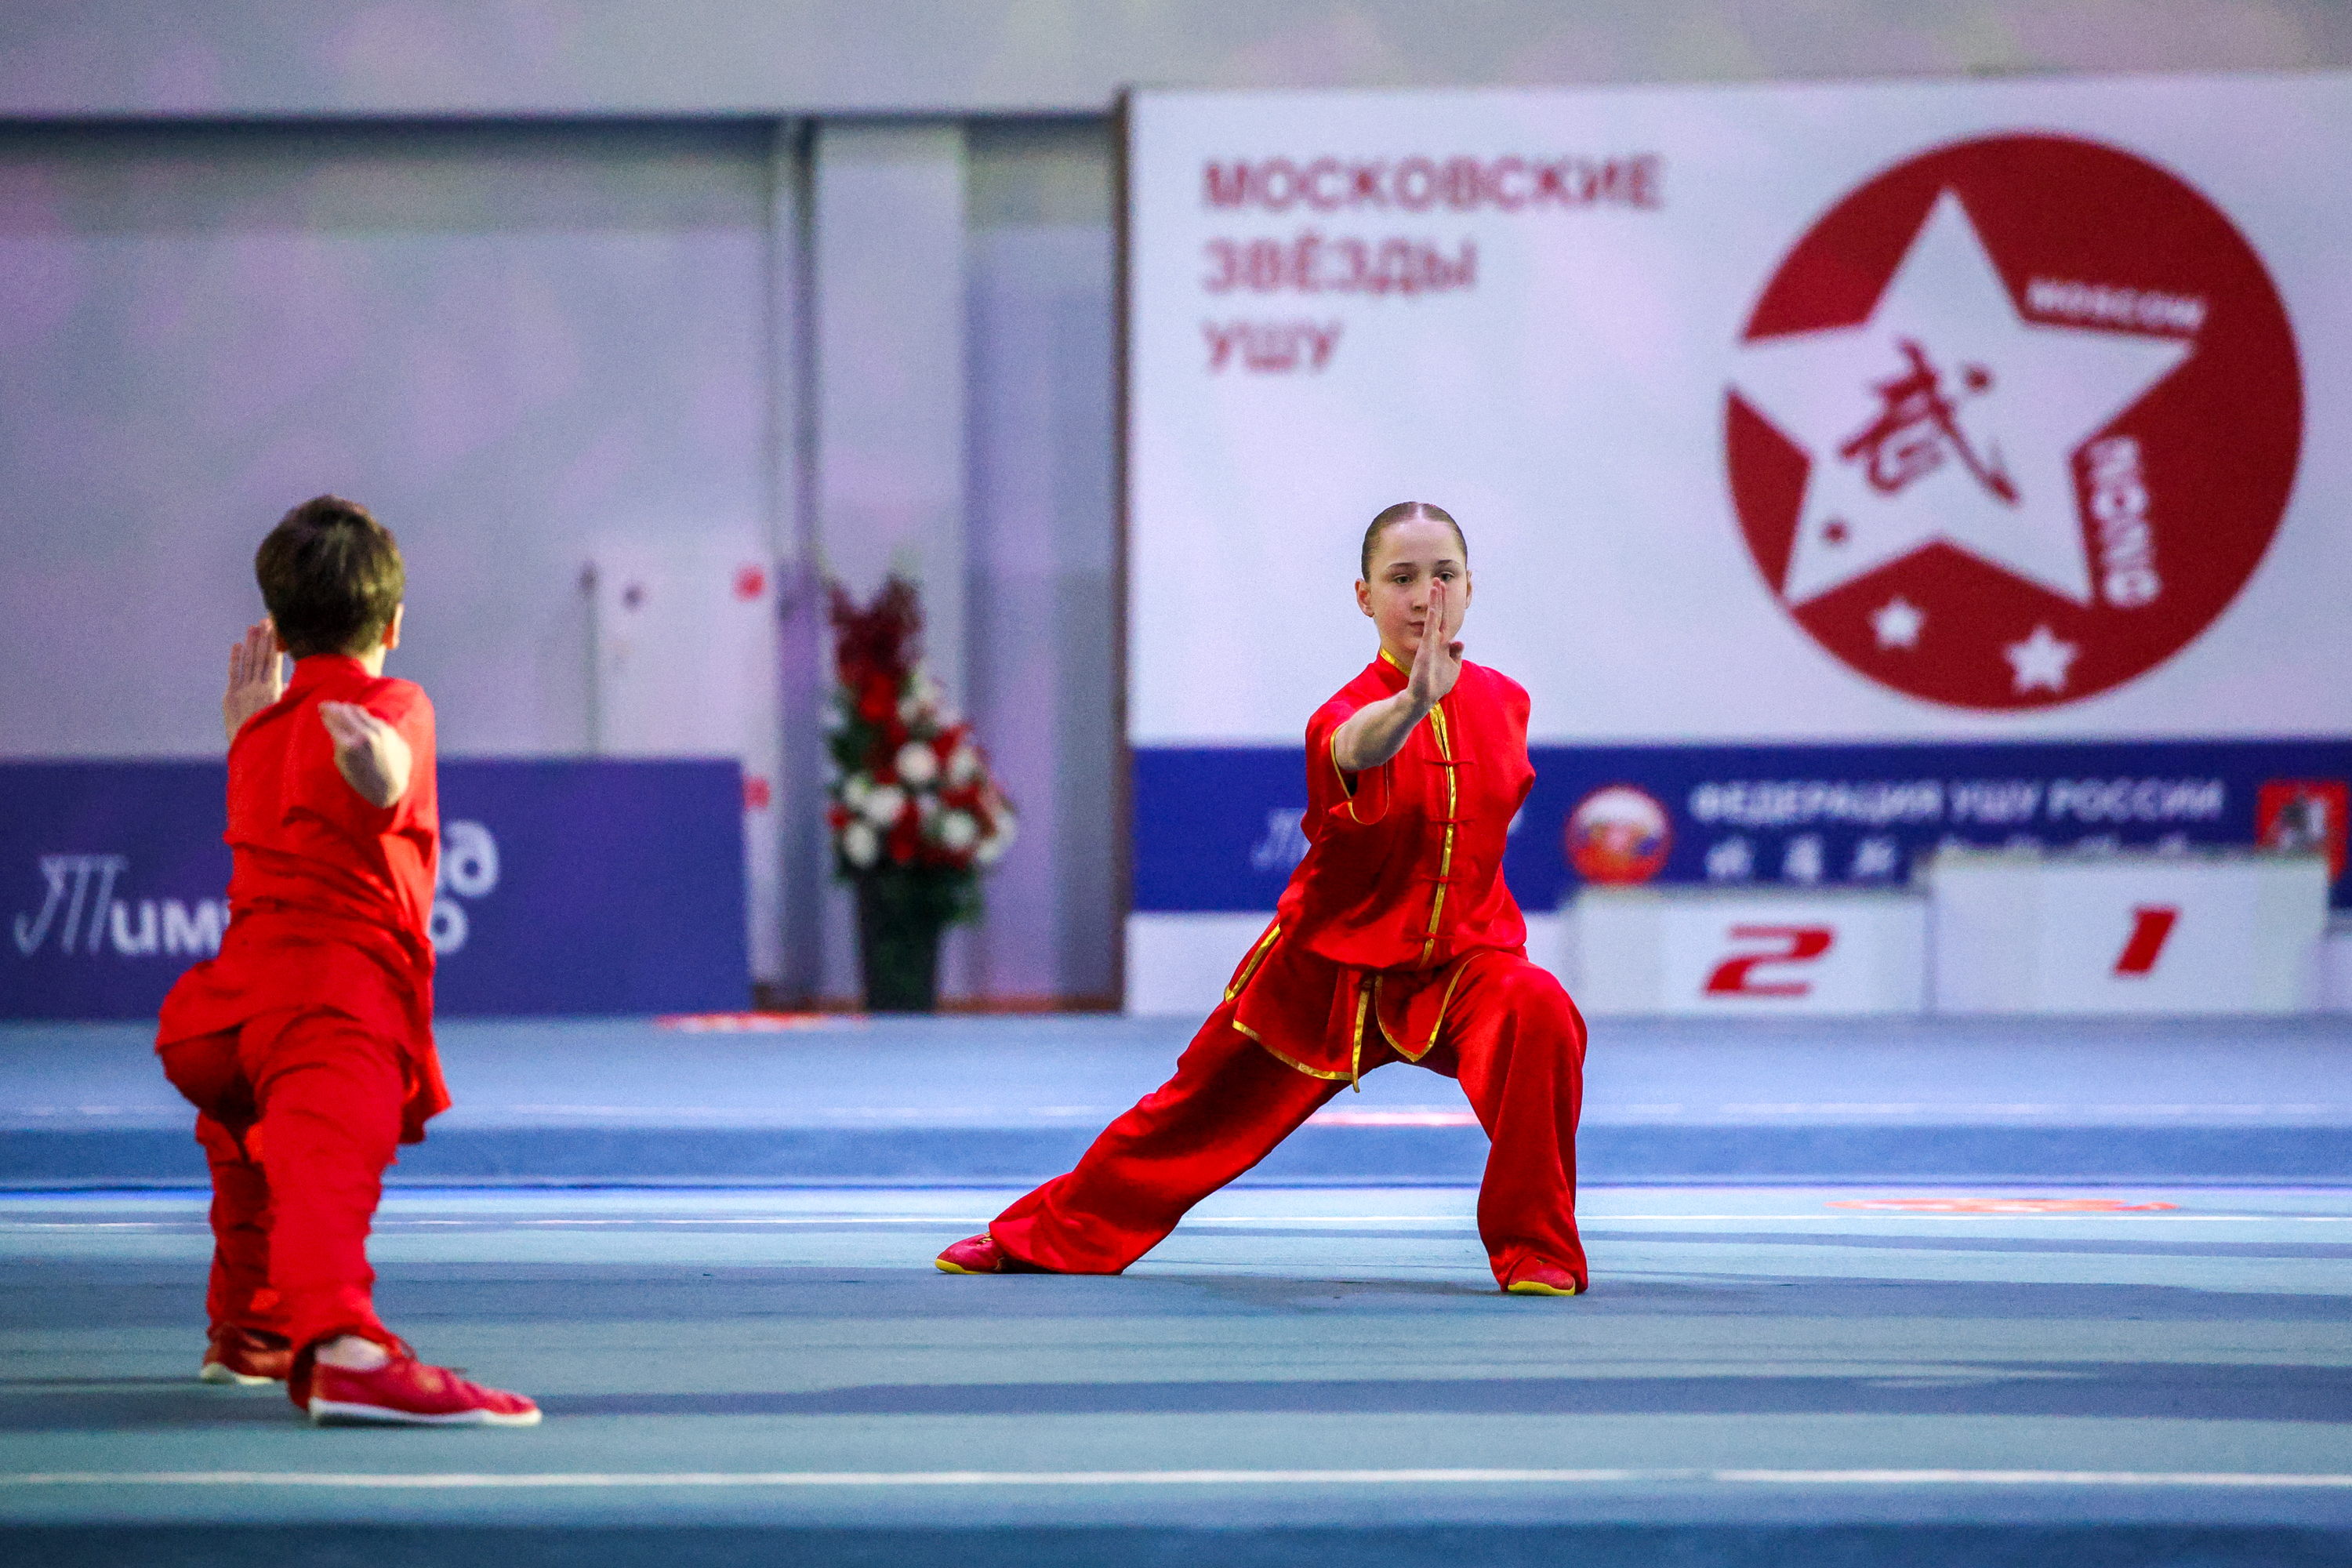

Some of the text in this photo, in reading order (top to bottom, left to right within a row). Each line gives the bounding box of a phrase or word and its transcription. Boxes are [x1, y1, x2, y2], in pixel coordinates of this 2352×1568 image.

[1203, 154, 1664, 212] МОСКОВСКИЕ
[1203, 230, 1477, 298] ЗВЁЗДЫ
[2026, 276, 2206, 331] MOSCOW
[1203, 319, 1342, 372] УШУ
[1689, 779, 2223, 825] ФЕДЕРАЦИЯ УШУ РОССИИ
[1701, 924, 1836, 996] 2
[2111, 905, 2182, 977] 1
